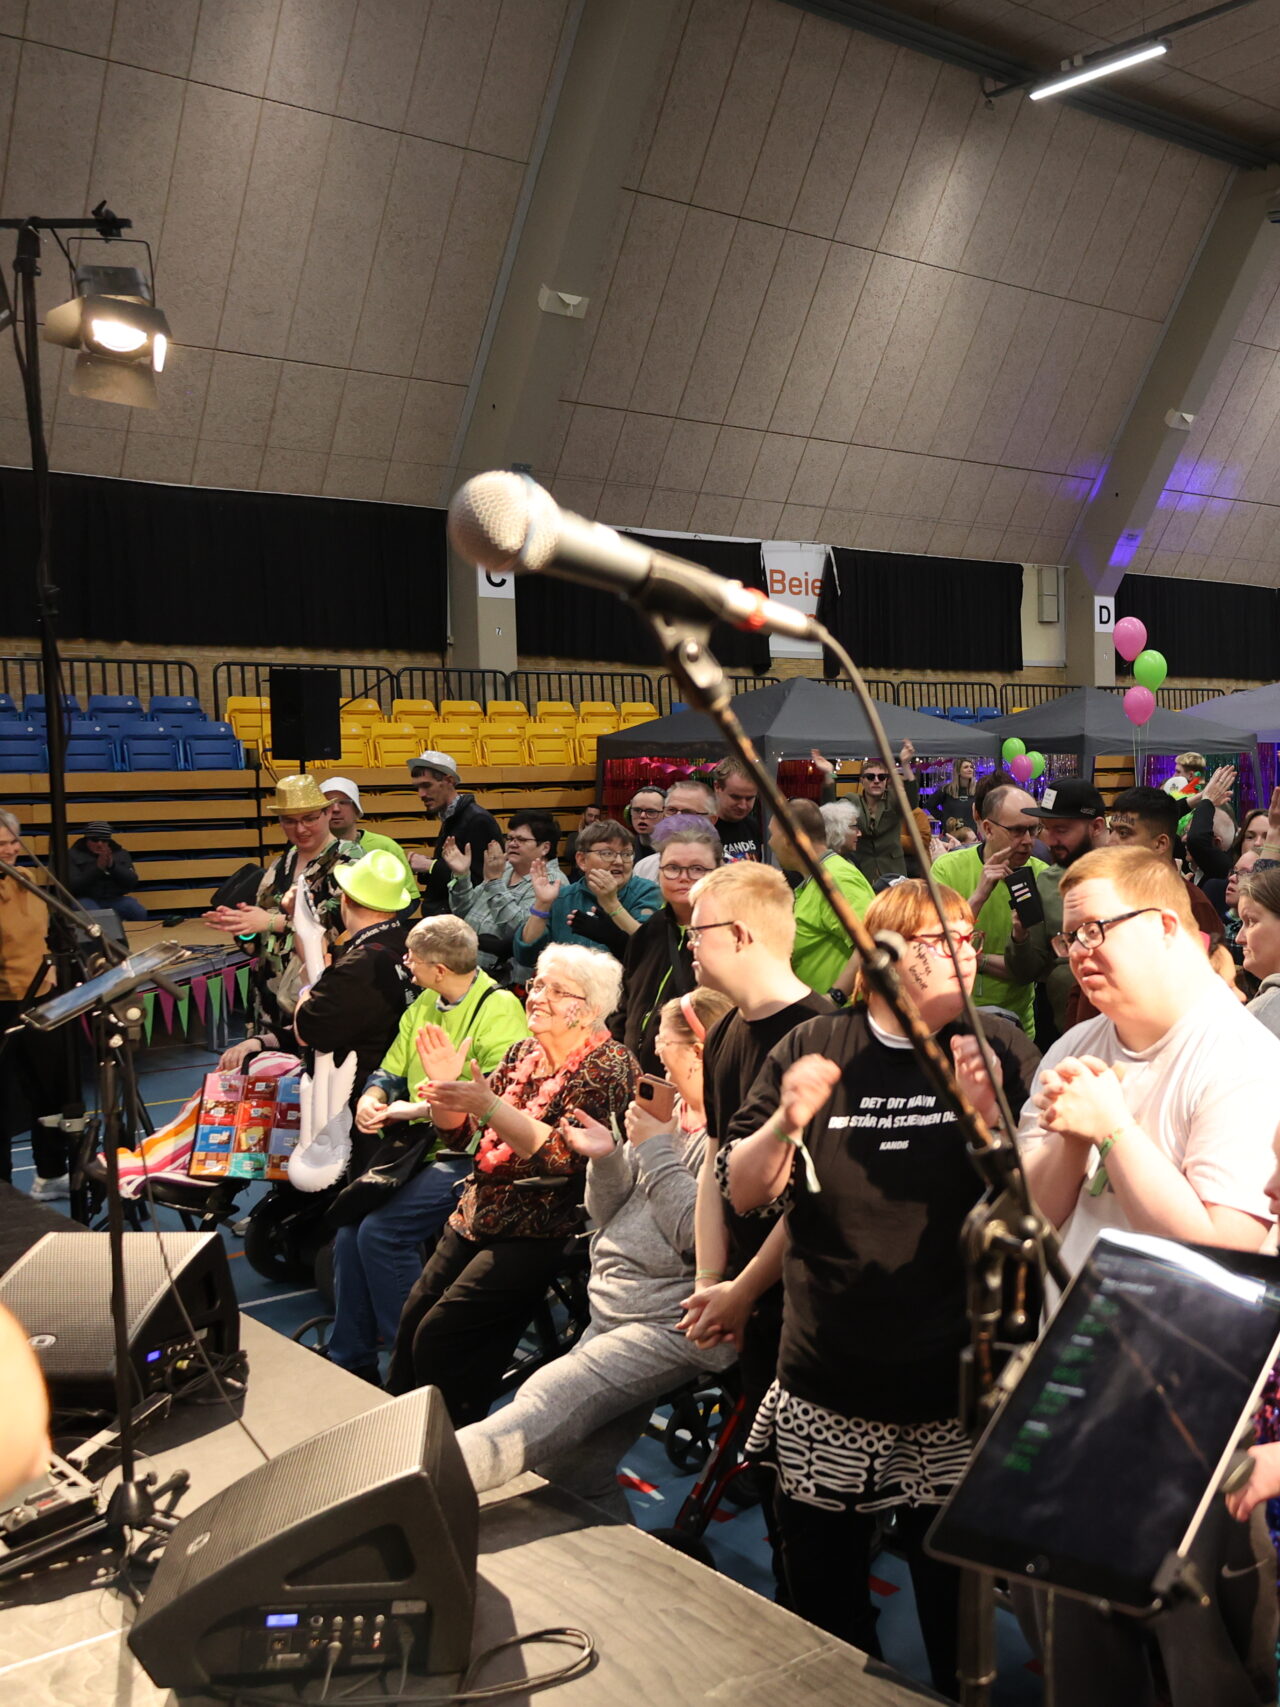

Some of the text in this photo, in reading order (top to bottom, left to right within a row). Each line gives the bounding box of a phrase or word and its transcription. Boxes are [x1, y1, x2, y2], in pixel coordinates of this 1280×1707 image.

[769, 568, 824, 597] Beie
[1099, 605, 1111, 624] D
[859, 1097, 886, 1109] DET
[886, 1097, 907, 1110] DIT
[849, 1113, 877, 1127] STÅR
[877, 1114, 893, 1129] PÅ
